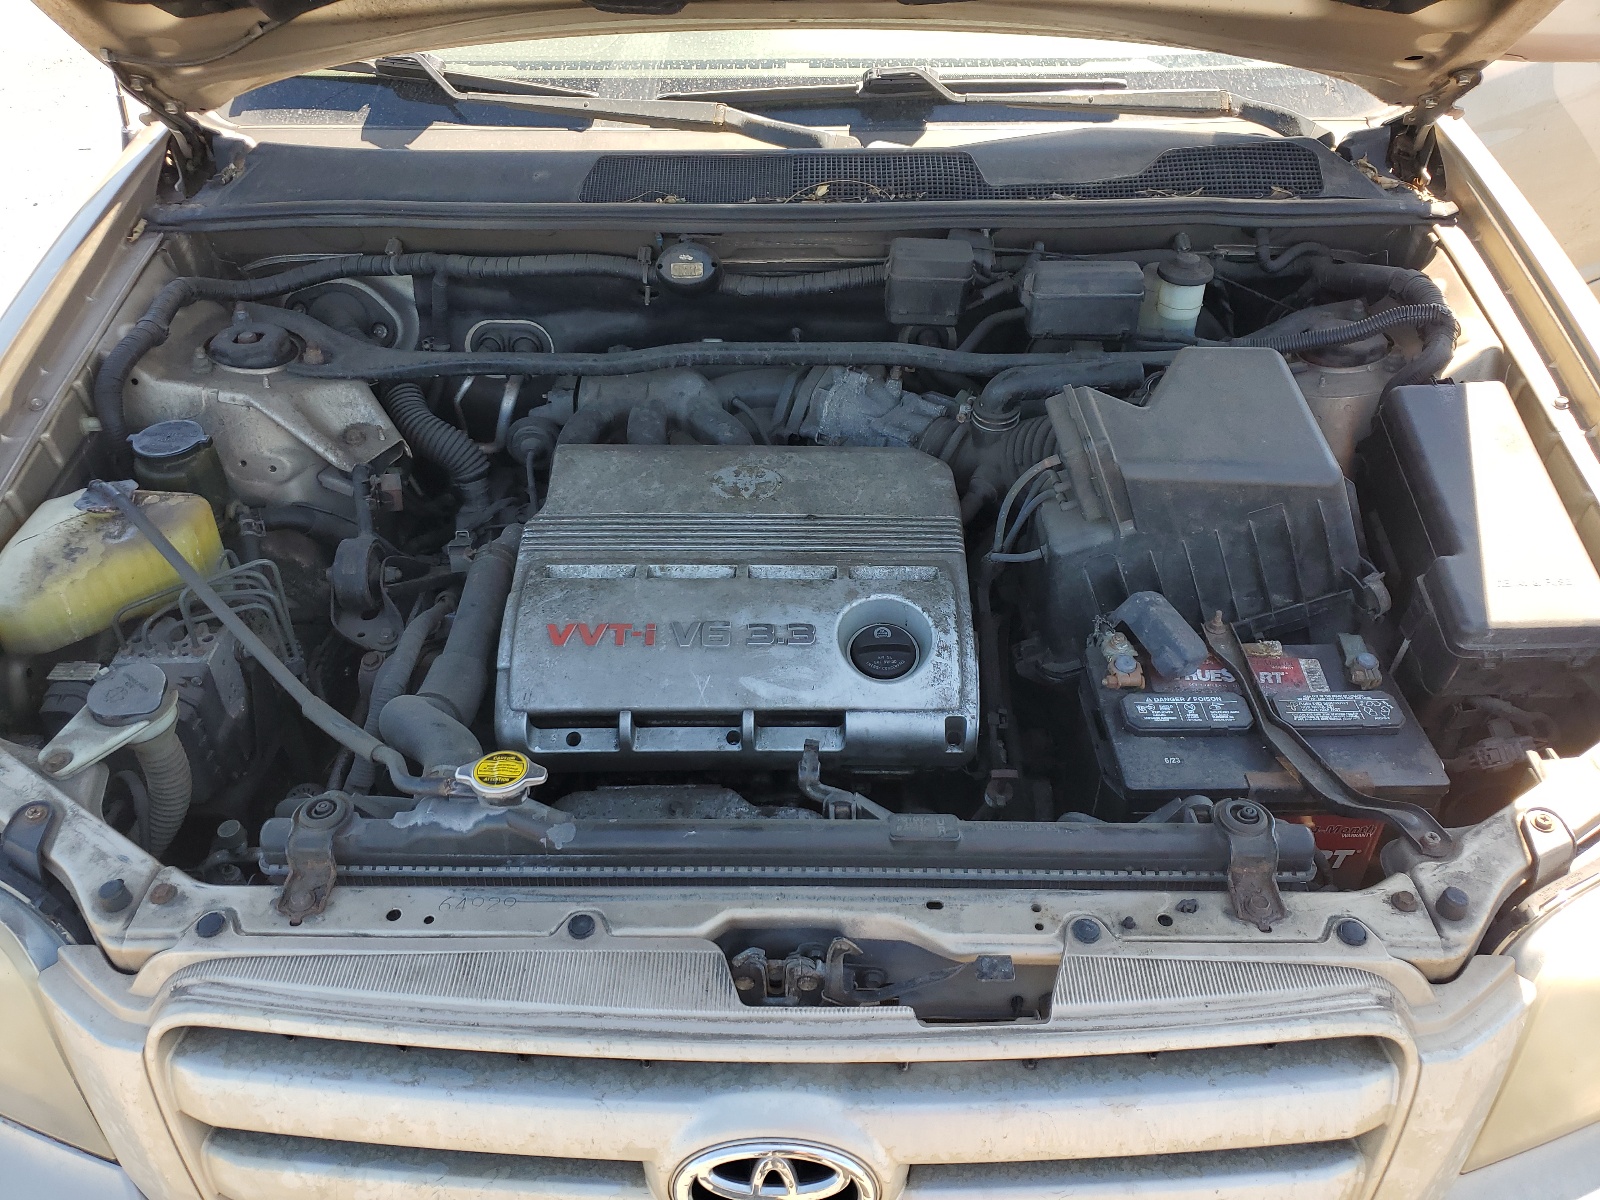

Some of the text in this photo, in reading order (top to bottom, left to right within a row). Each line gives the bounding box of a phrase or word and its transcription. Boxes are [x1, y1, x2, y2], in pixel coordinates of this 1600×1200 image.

[546, 621, 818, 648] VVT-i V6 3.3
